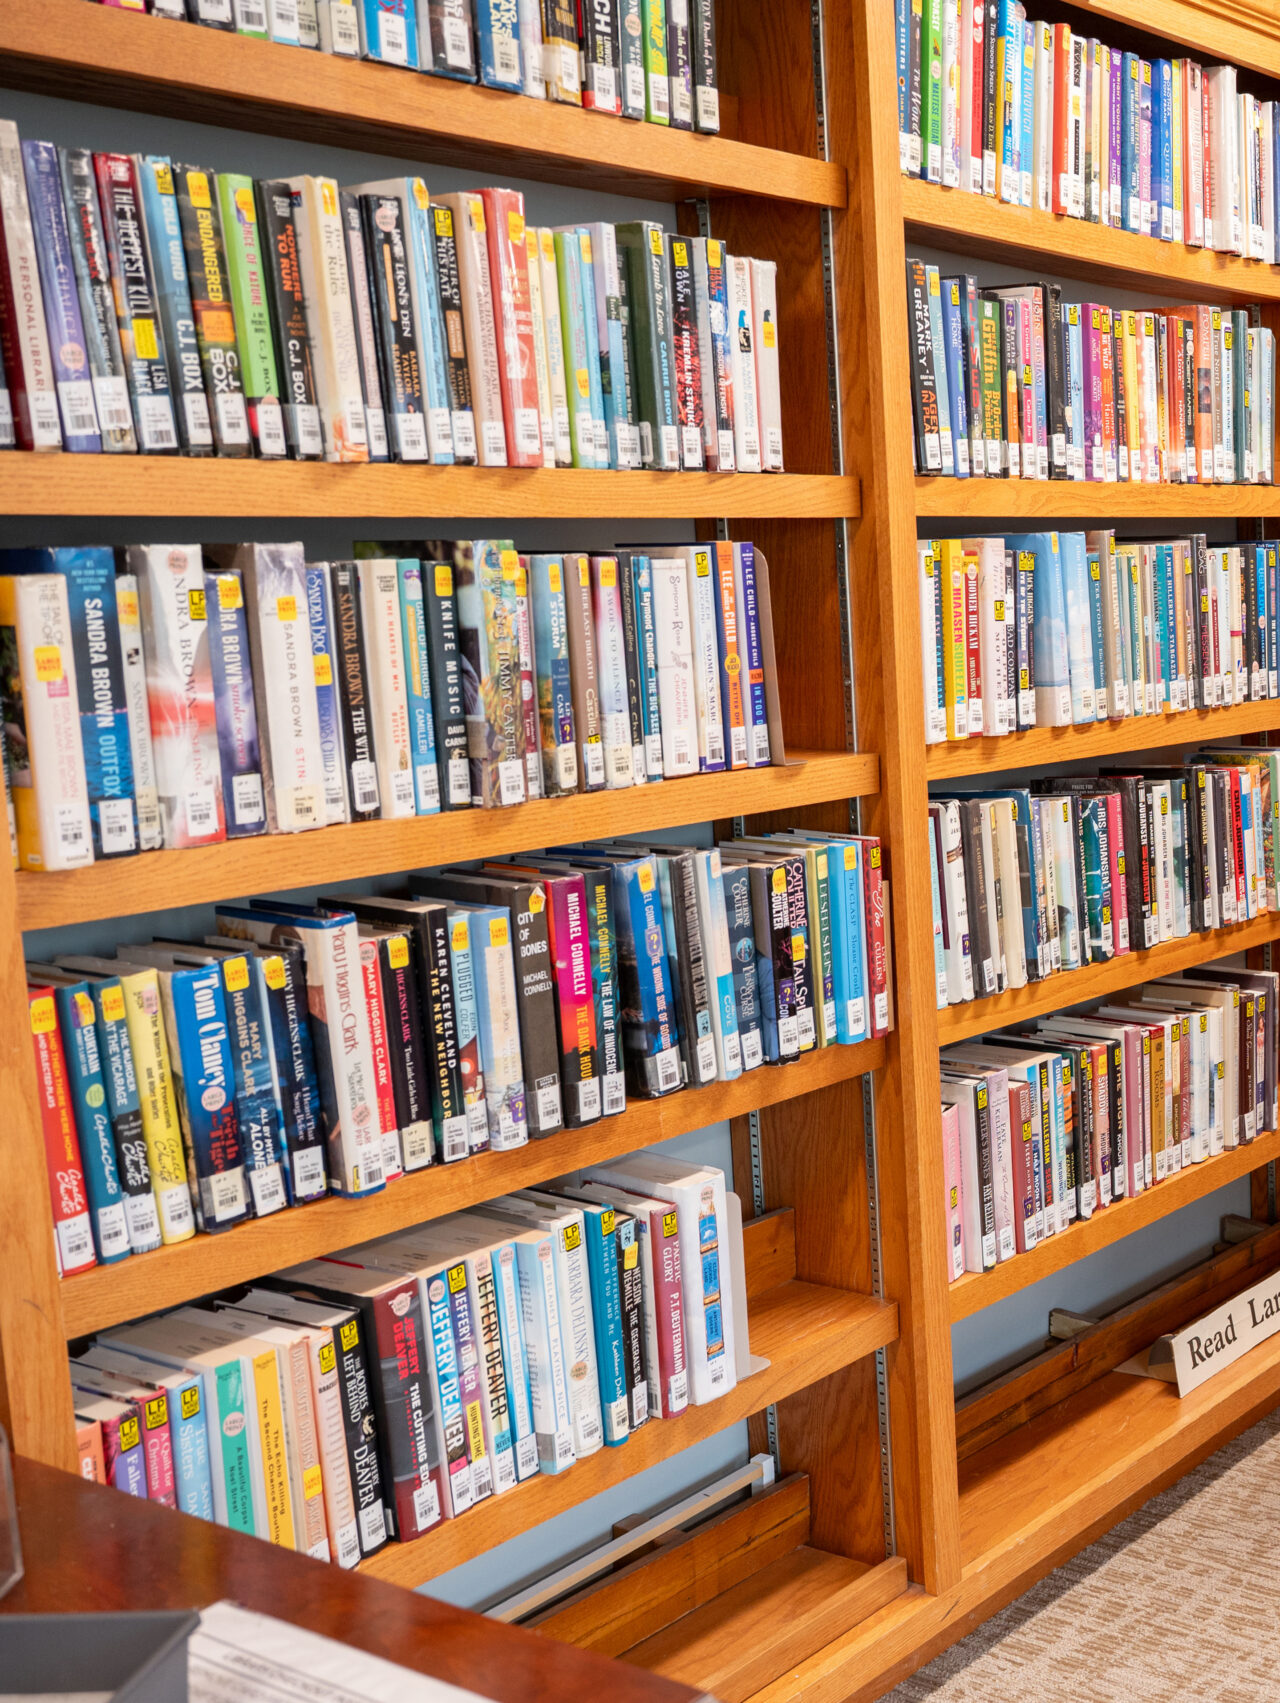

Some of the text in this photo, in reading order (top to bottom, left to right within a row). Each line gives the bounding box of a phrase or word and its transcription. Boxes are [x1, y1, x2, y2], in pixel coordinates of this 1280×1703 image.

[196, 209, 224, 302] ENDANGERED
[285, 224, 302, 302] NOWHERE
[18, 256, 37, 331] PERSONAL
[913, 288, 927, 366] GREANEY
[922, 304, 932, 351] MARK
[209, 348, 228, 393] BOX
[721, 570, 733, 589] LEE
[745, 569, 756, 616] LEE CHILD
[550, 600, 561, 649] STORM
[640, 592, 656, 668] Raymond Chandler
[724, 611, 736, 643] CHILD
[952, 588, 963, 643] HIAASEN
[968, 581, 979, 649] HOMER HICKAM
[1006, 624, 1014, 648] BAD
[222, 635, 243, 685] BROWN
[339, 593, 367, 734] SANDRA BROWN THE
[415, 602, 430, 700] GAME OF MIRRORS
[441, 601, 461, 714] KNIFE MUSIC
[84, 598, 122, 797] SANDRA BROWN OUTFOX
[283, 623, 304, 739] SANDRA BROWN
[415, 709, 428, 754] CAMILLERI
[426, 713, 435, 748] ANDREA
[448, 725, 465, 734] DAVID
[586, 688, 596, 735] Castillo
[1097, 807, 1110, 884] IRIS JOHANSEN
[517, 912, 534, 925] CITY
[792, 862, 808, 929] CATHERINE
[519, 929, 530, 941] OF
[520, 940, 548, 957] BONES
[595, 885, 614, 1032] MICHAEL CONNELLY THE LAW OF
[435, 928, 457, 1070] KAREN CLEVELAND
[456, 953, 474, 1003] PLUGGED
[523, 971, 548, 984] MICHAEL
[524, 981, 553, 997] CONNELLY
[567, 892, 591, 1053] MICHAEL CONNELLY THE DARK
[83, 1024, 100, 1074] CURTAIN
[193, 972, 226, 1087] Tom Clancy
[233, 991, 257, 1097] HIGGINS CLARK
[249, 1021, 263, 1060] MARY
[366, 963, 388, 1086] MARY HIGGINS CLARK
[429, 969, 452, 1118] THE NEW NEIGHBOR
[111, 1059, 128, 1107] VICARAGE
[250, 1123, 267, 1169] ALONE
[1042, 1112, 1051, 1164] KELLERMAN
[663, 1247, 674, 1283] GLORY
[567, 1250, 590, 1363] BARBARA DELINSKY
[392, 1321, 409, 1381] DEAVER
[404, 1317, 420, 1375] JEFFERY
[454, 1294, 477, 1393] JEFFERY DEAVER
[477, 1272, 508, 1420] JEFFERY DEAVER
[1187, 1313, 1238, 1370] Read
[343, 1354, 361, 1423] LEFT BEHIND
[356, 1370, 369, 1410] BODIES
[431, 1303, 465, 1452] JEFFERY DEAVER
[264, 1421, 273, 1461] Second
[409, 1382, 428, 1465] THE CUTTING
[147, 1438, 159, 1492] Christmas
[179, 1424, 194, 1480] Sisters
[353, 1445, 374, 1510] DEAVER
[268, 1463, 276, 1503] Chance
